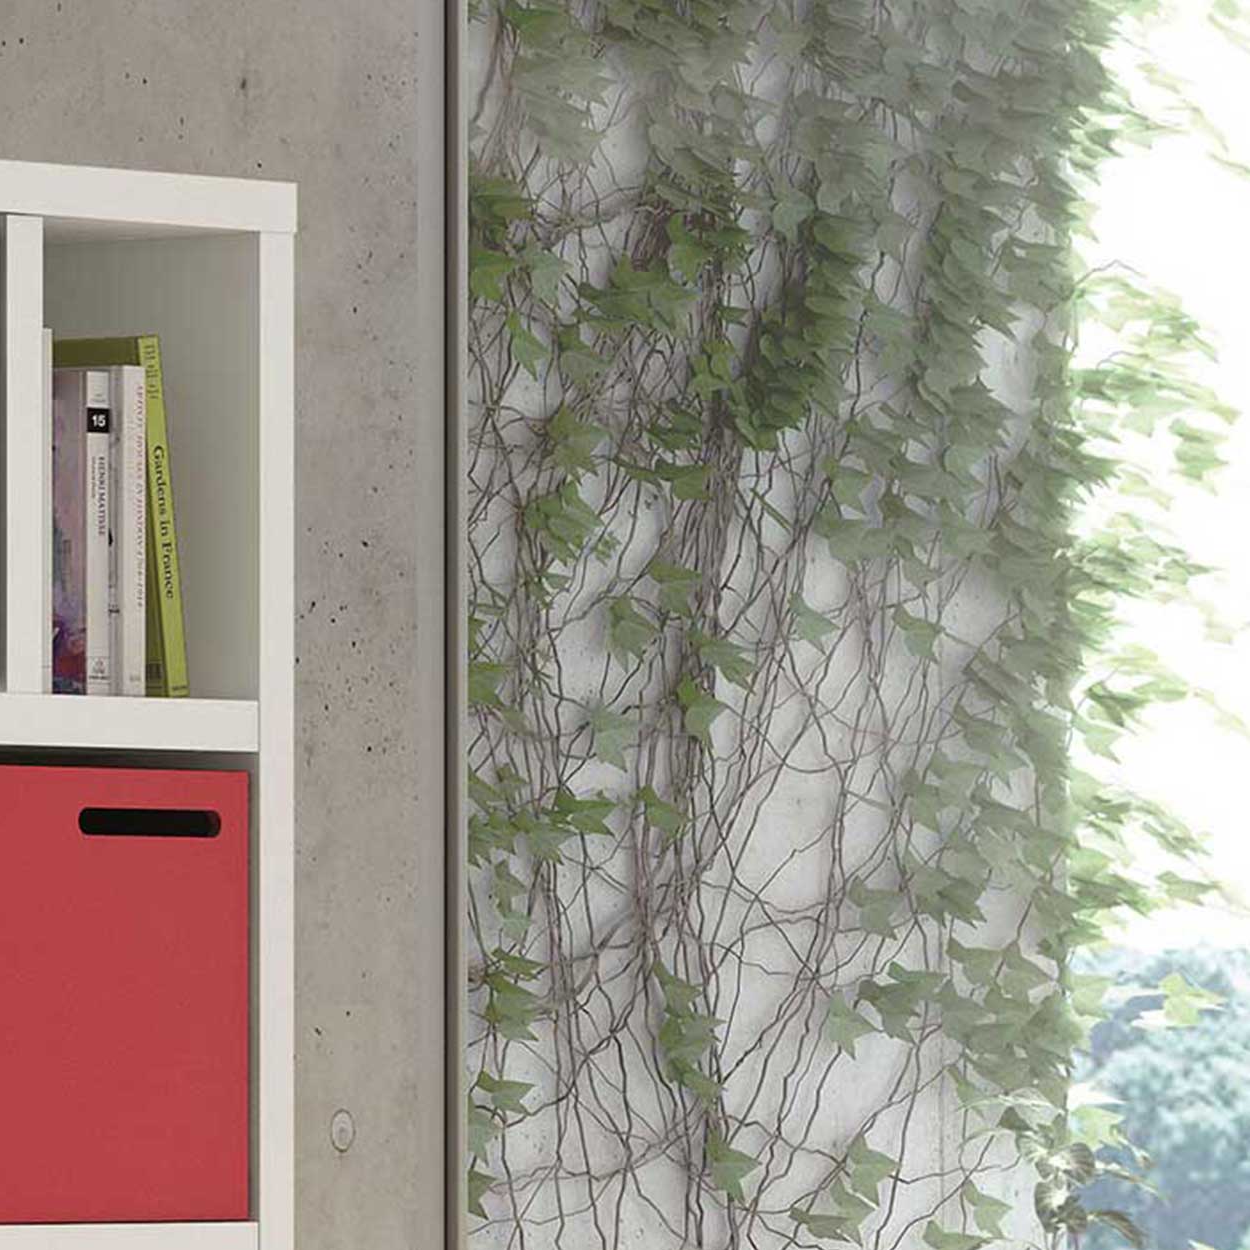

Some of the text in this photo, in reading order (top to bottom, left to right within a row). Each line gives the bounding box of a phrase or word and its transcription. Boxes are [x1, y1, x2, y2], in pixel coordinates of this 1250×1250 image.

[93, 415, 106, 427] 15
[153, 445, 174, 599] Gardens in France
